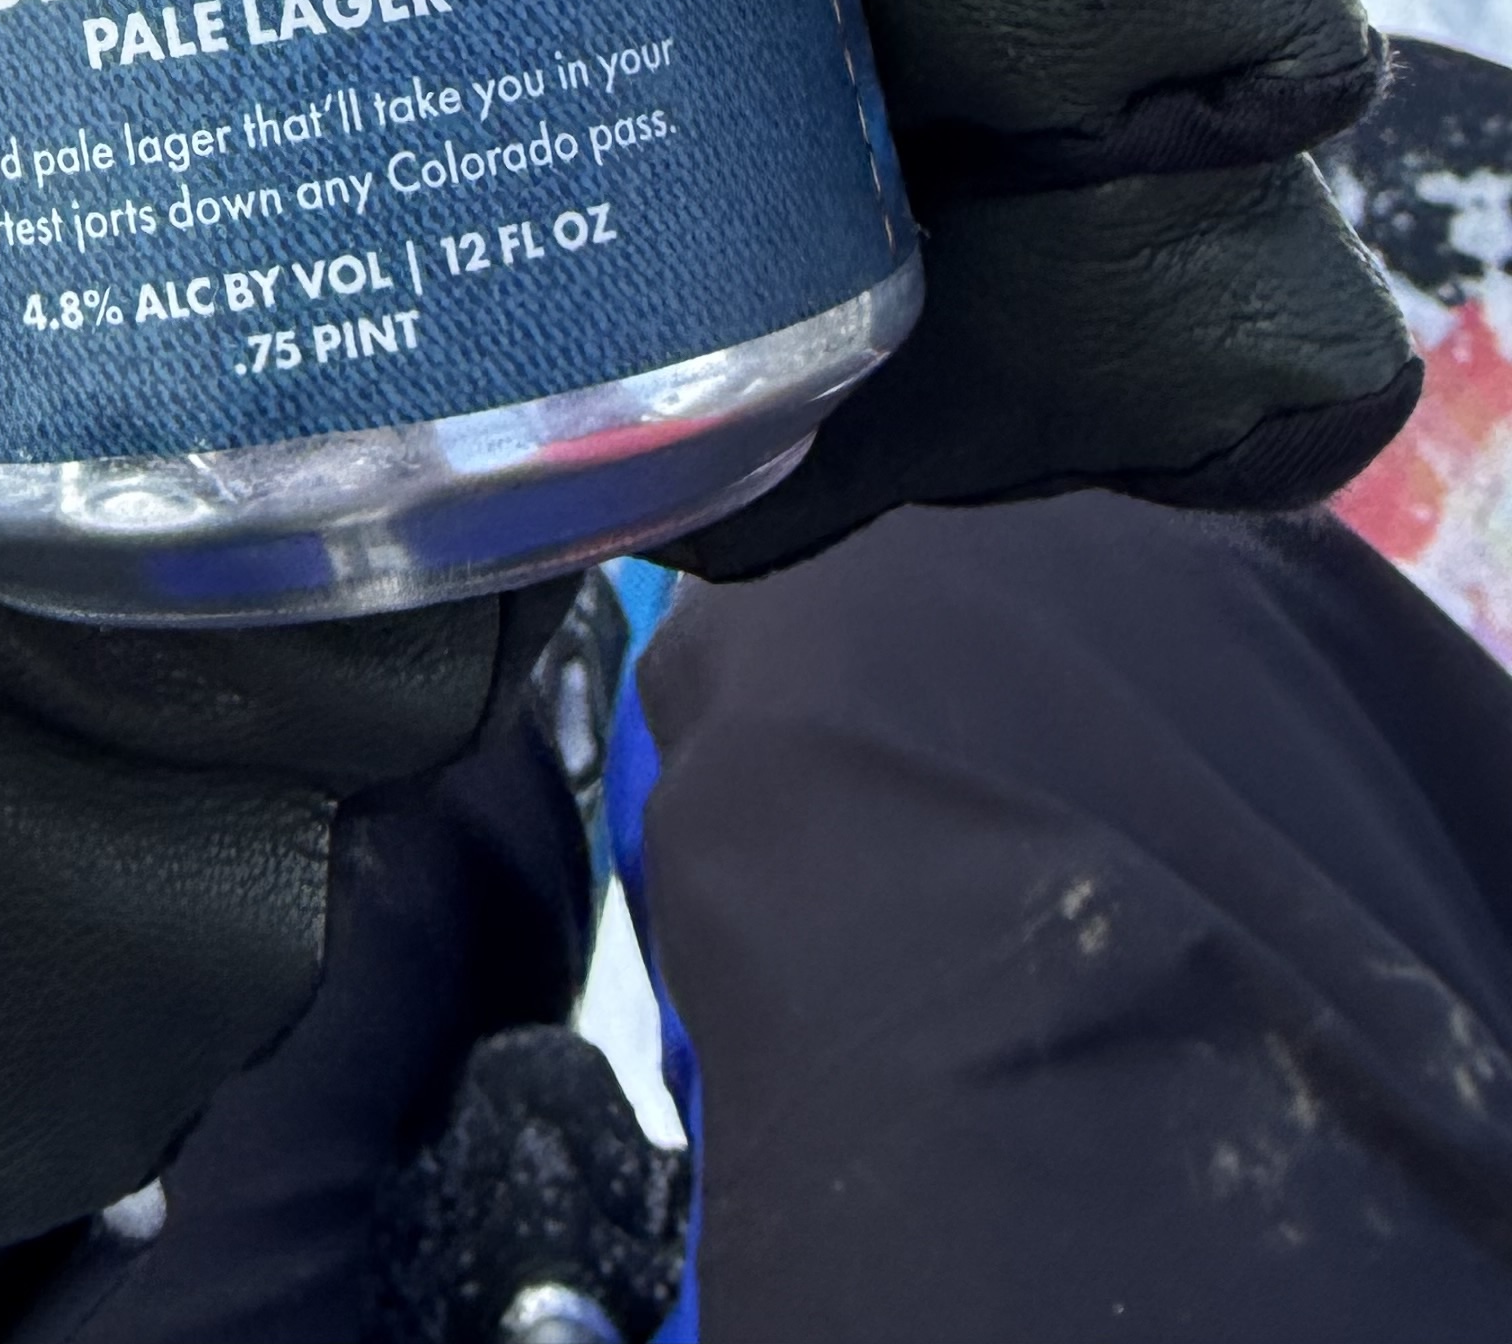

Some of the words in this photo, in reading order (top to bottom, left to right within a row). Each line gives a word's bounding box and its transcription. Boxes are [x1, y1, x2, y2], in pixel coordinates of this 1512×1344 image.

[31, 127, 117, 195] pale
[123, 121, 232, 174] lager
[373, 75, 463, 127] take
[471, 69, 545, 122] you
[554, 50, 590, 90] in
[596, 39, 673, 94] your
[70, 198, 157, 255] jorts
[168, 181, 284, 232] down
[296, 171, 373, 215] any
[387, 120, 579, 195] Colorado
[588, 109, 677, 167] pass.
[22, 285, 125, 341] 4.8%
[134, 276, 216, 324] ALC
[223, 264, 281, 313] BY
[291, 251, 394, 300] VOL
[440, 232, 491, 275] 12
[497, 221, 545, 266] FL
[553, 202, 617, 252] OZ
[232, 329, 302, 374] .75
[312, 309, 420, 364] PINT
